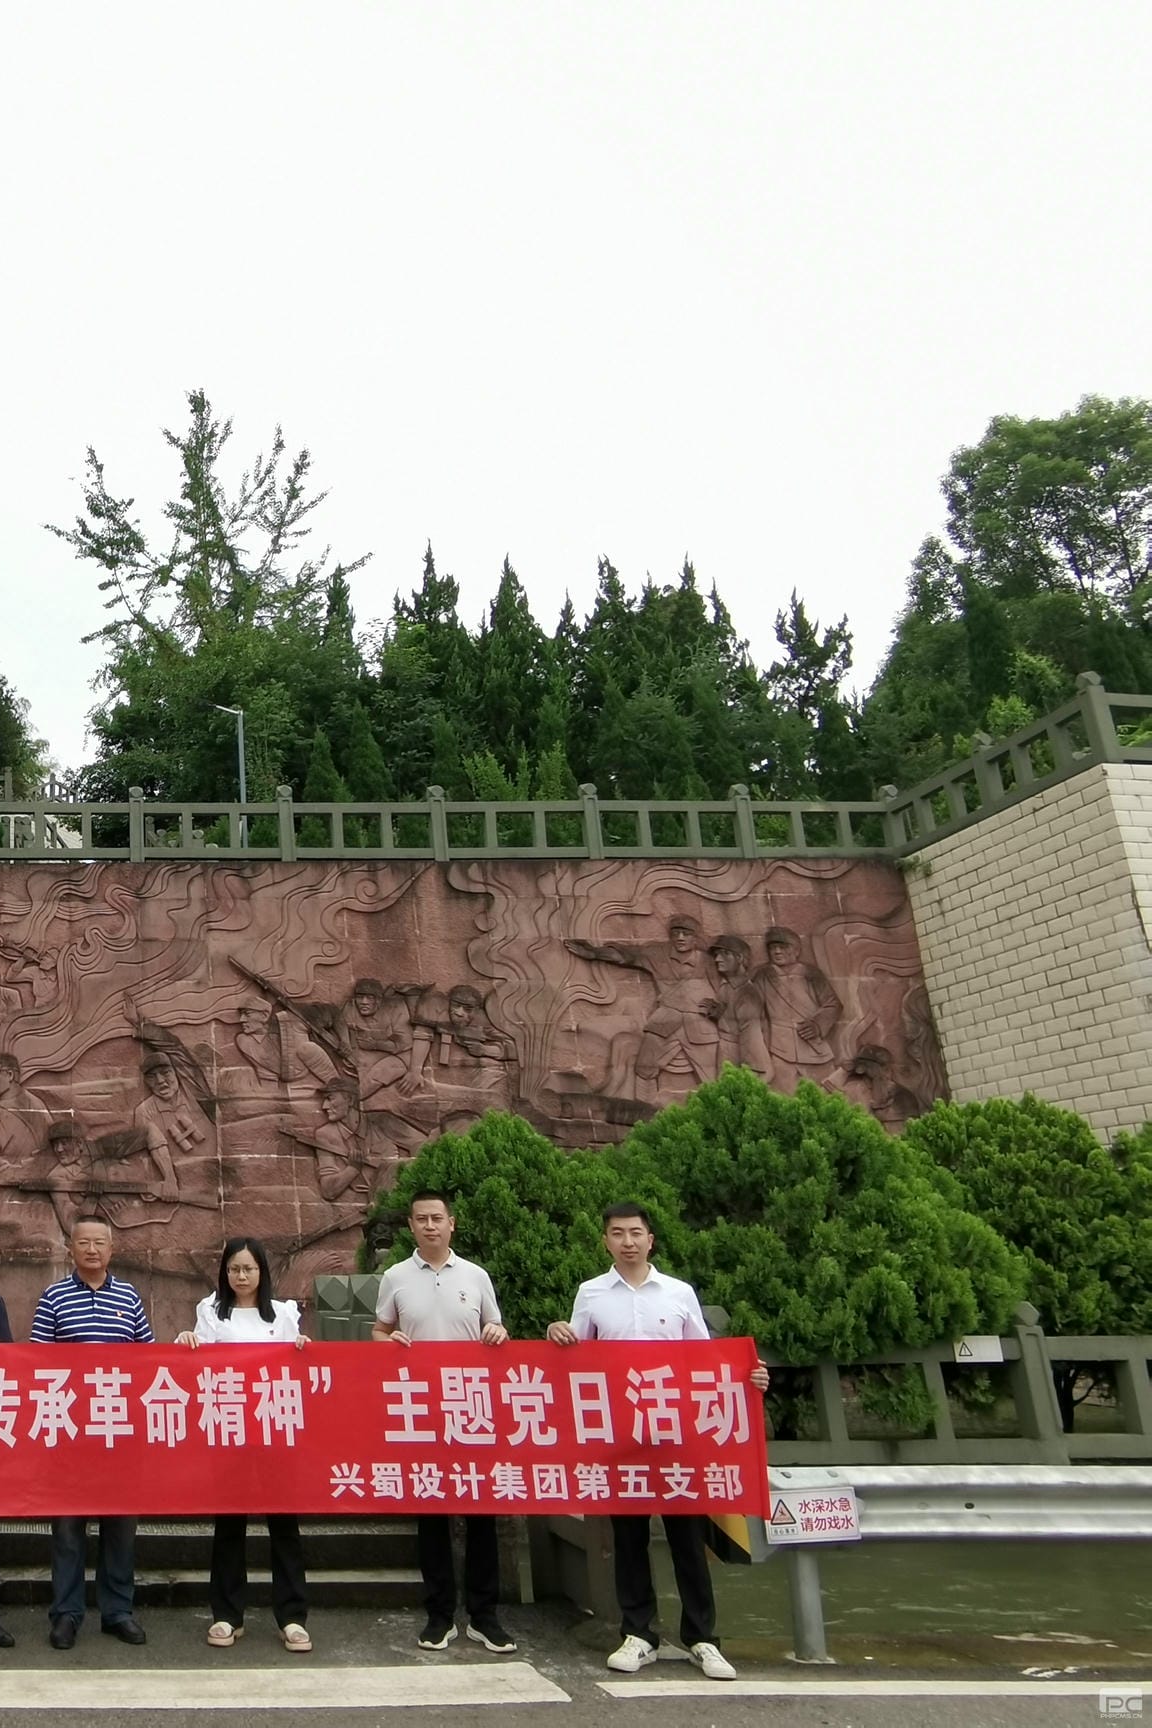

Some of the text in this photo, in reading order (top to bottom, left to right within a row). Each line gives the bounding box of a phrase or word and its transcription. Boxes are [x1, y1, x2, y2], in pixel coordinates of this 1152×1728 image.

[382, 1363, 751, 1449] 主题党日活动
[329, 1460, 743, 1502] 兴蜀设计集团第五支部
[798, 1496, 852, 1514] 水深水急
[800, 1515, 855, 1533] 请勿戏水
